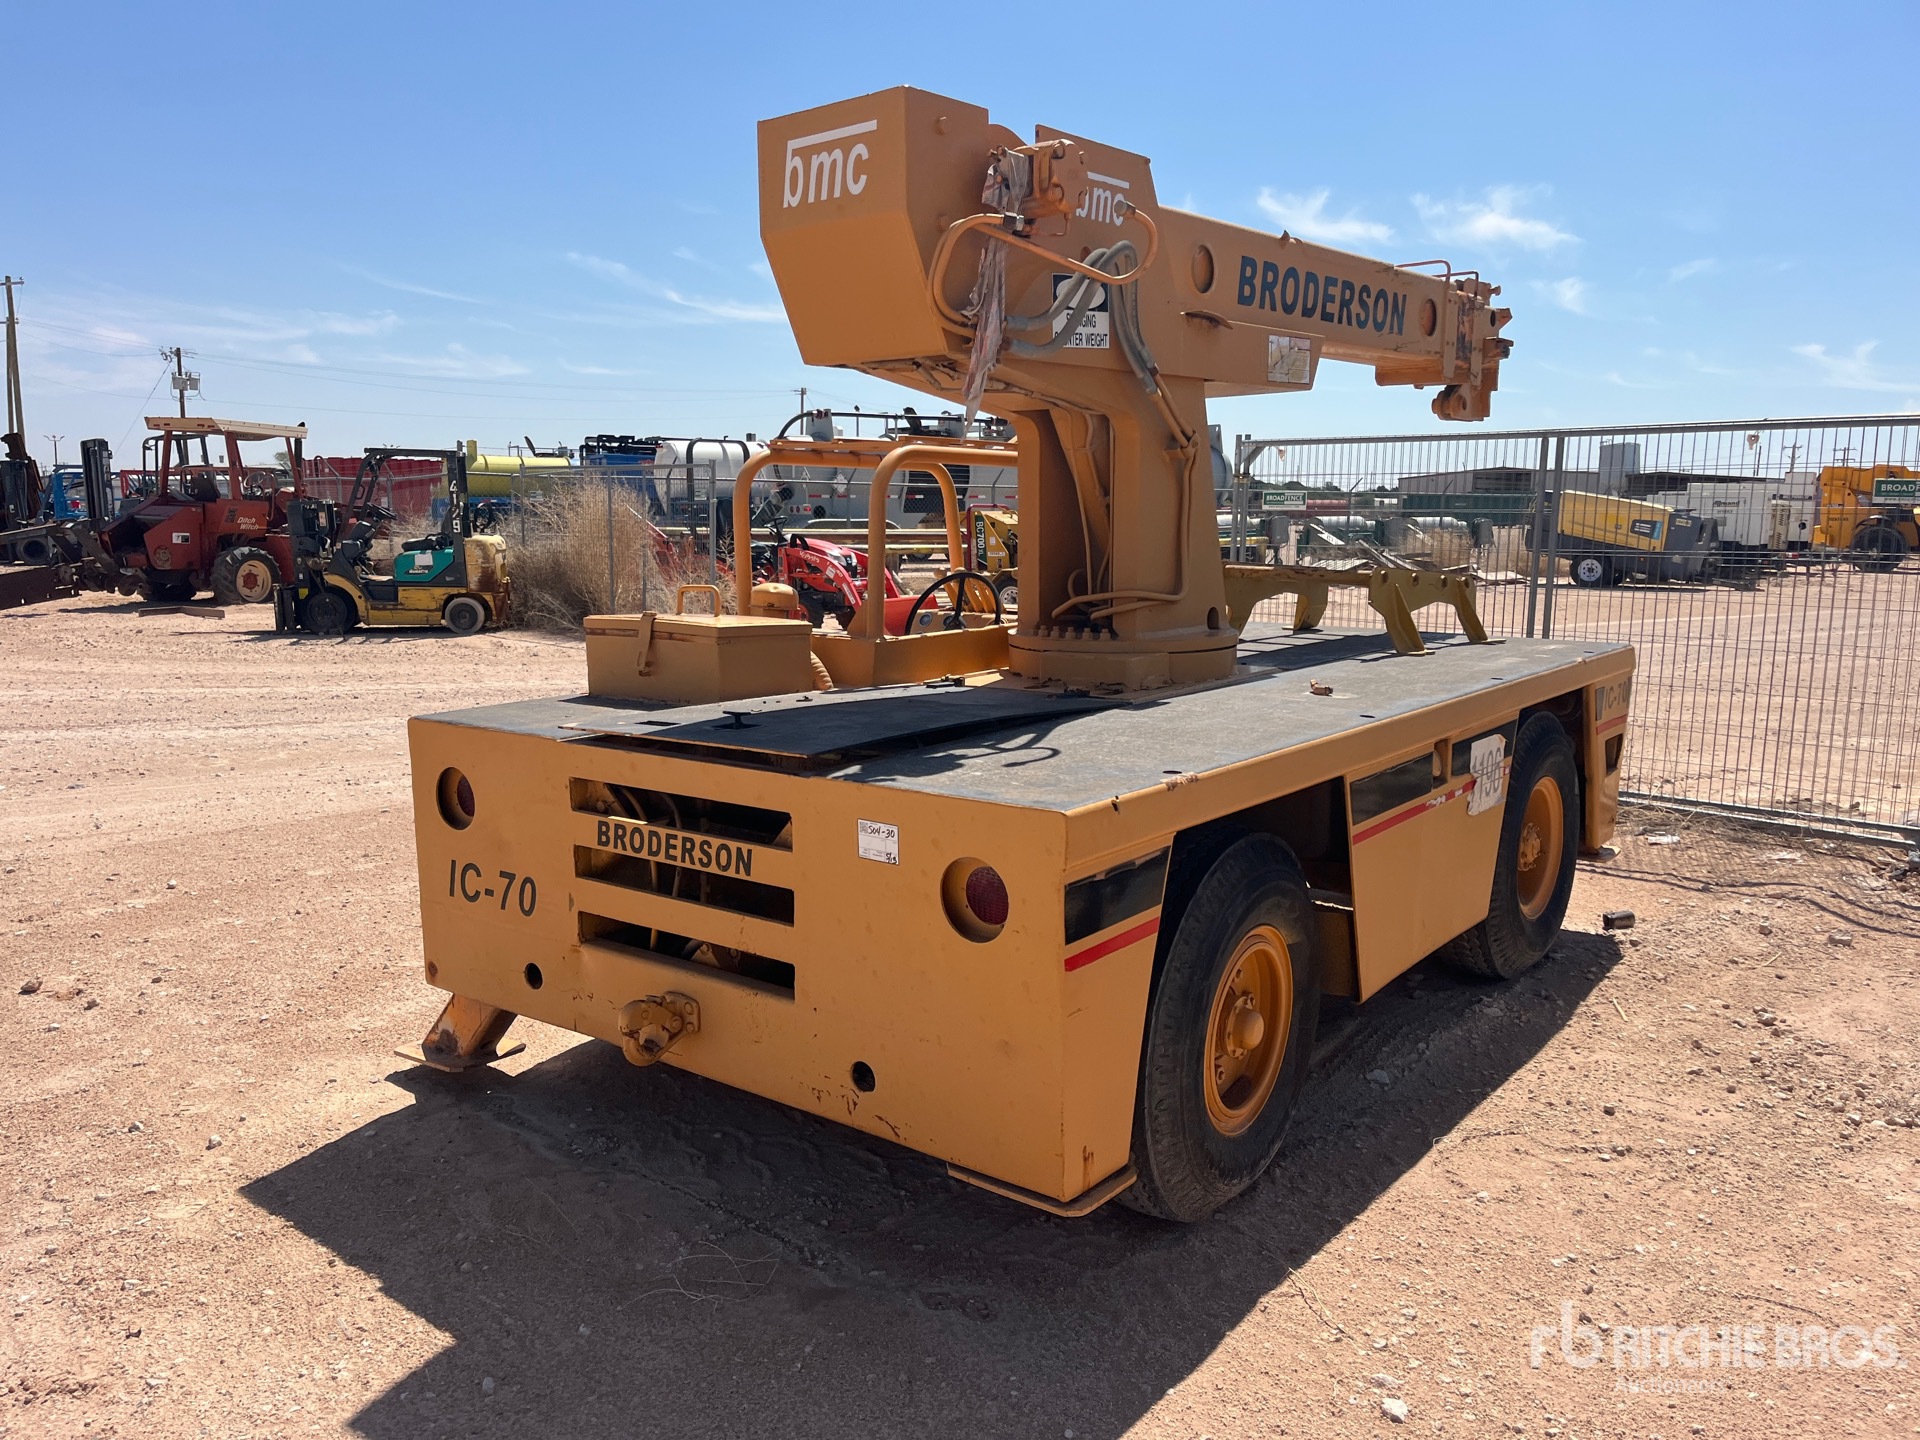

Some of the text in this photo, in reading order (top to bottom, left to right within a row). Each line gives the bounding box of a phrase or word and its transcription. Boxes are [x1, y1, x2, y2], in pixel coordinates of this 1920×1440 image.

[783, 119, 877, 208] bmc
[1237, 255, 1407, 336] BRODERSON
[1085, 333, 1108, 347] WEIGHT
[597, 819, 753, 877] BRODERSON
[449, 860, 538, 917] IC-70
